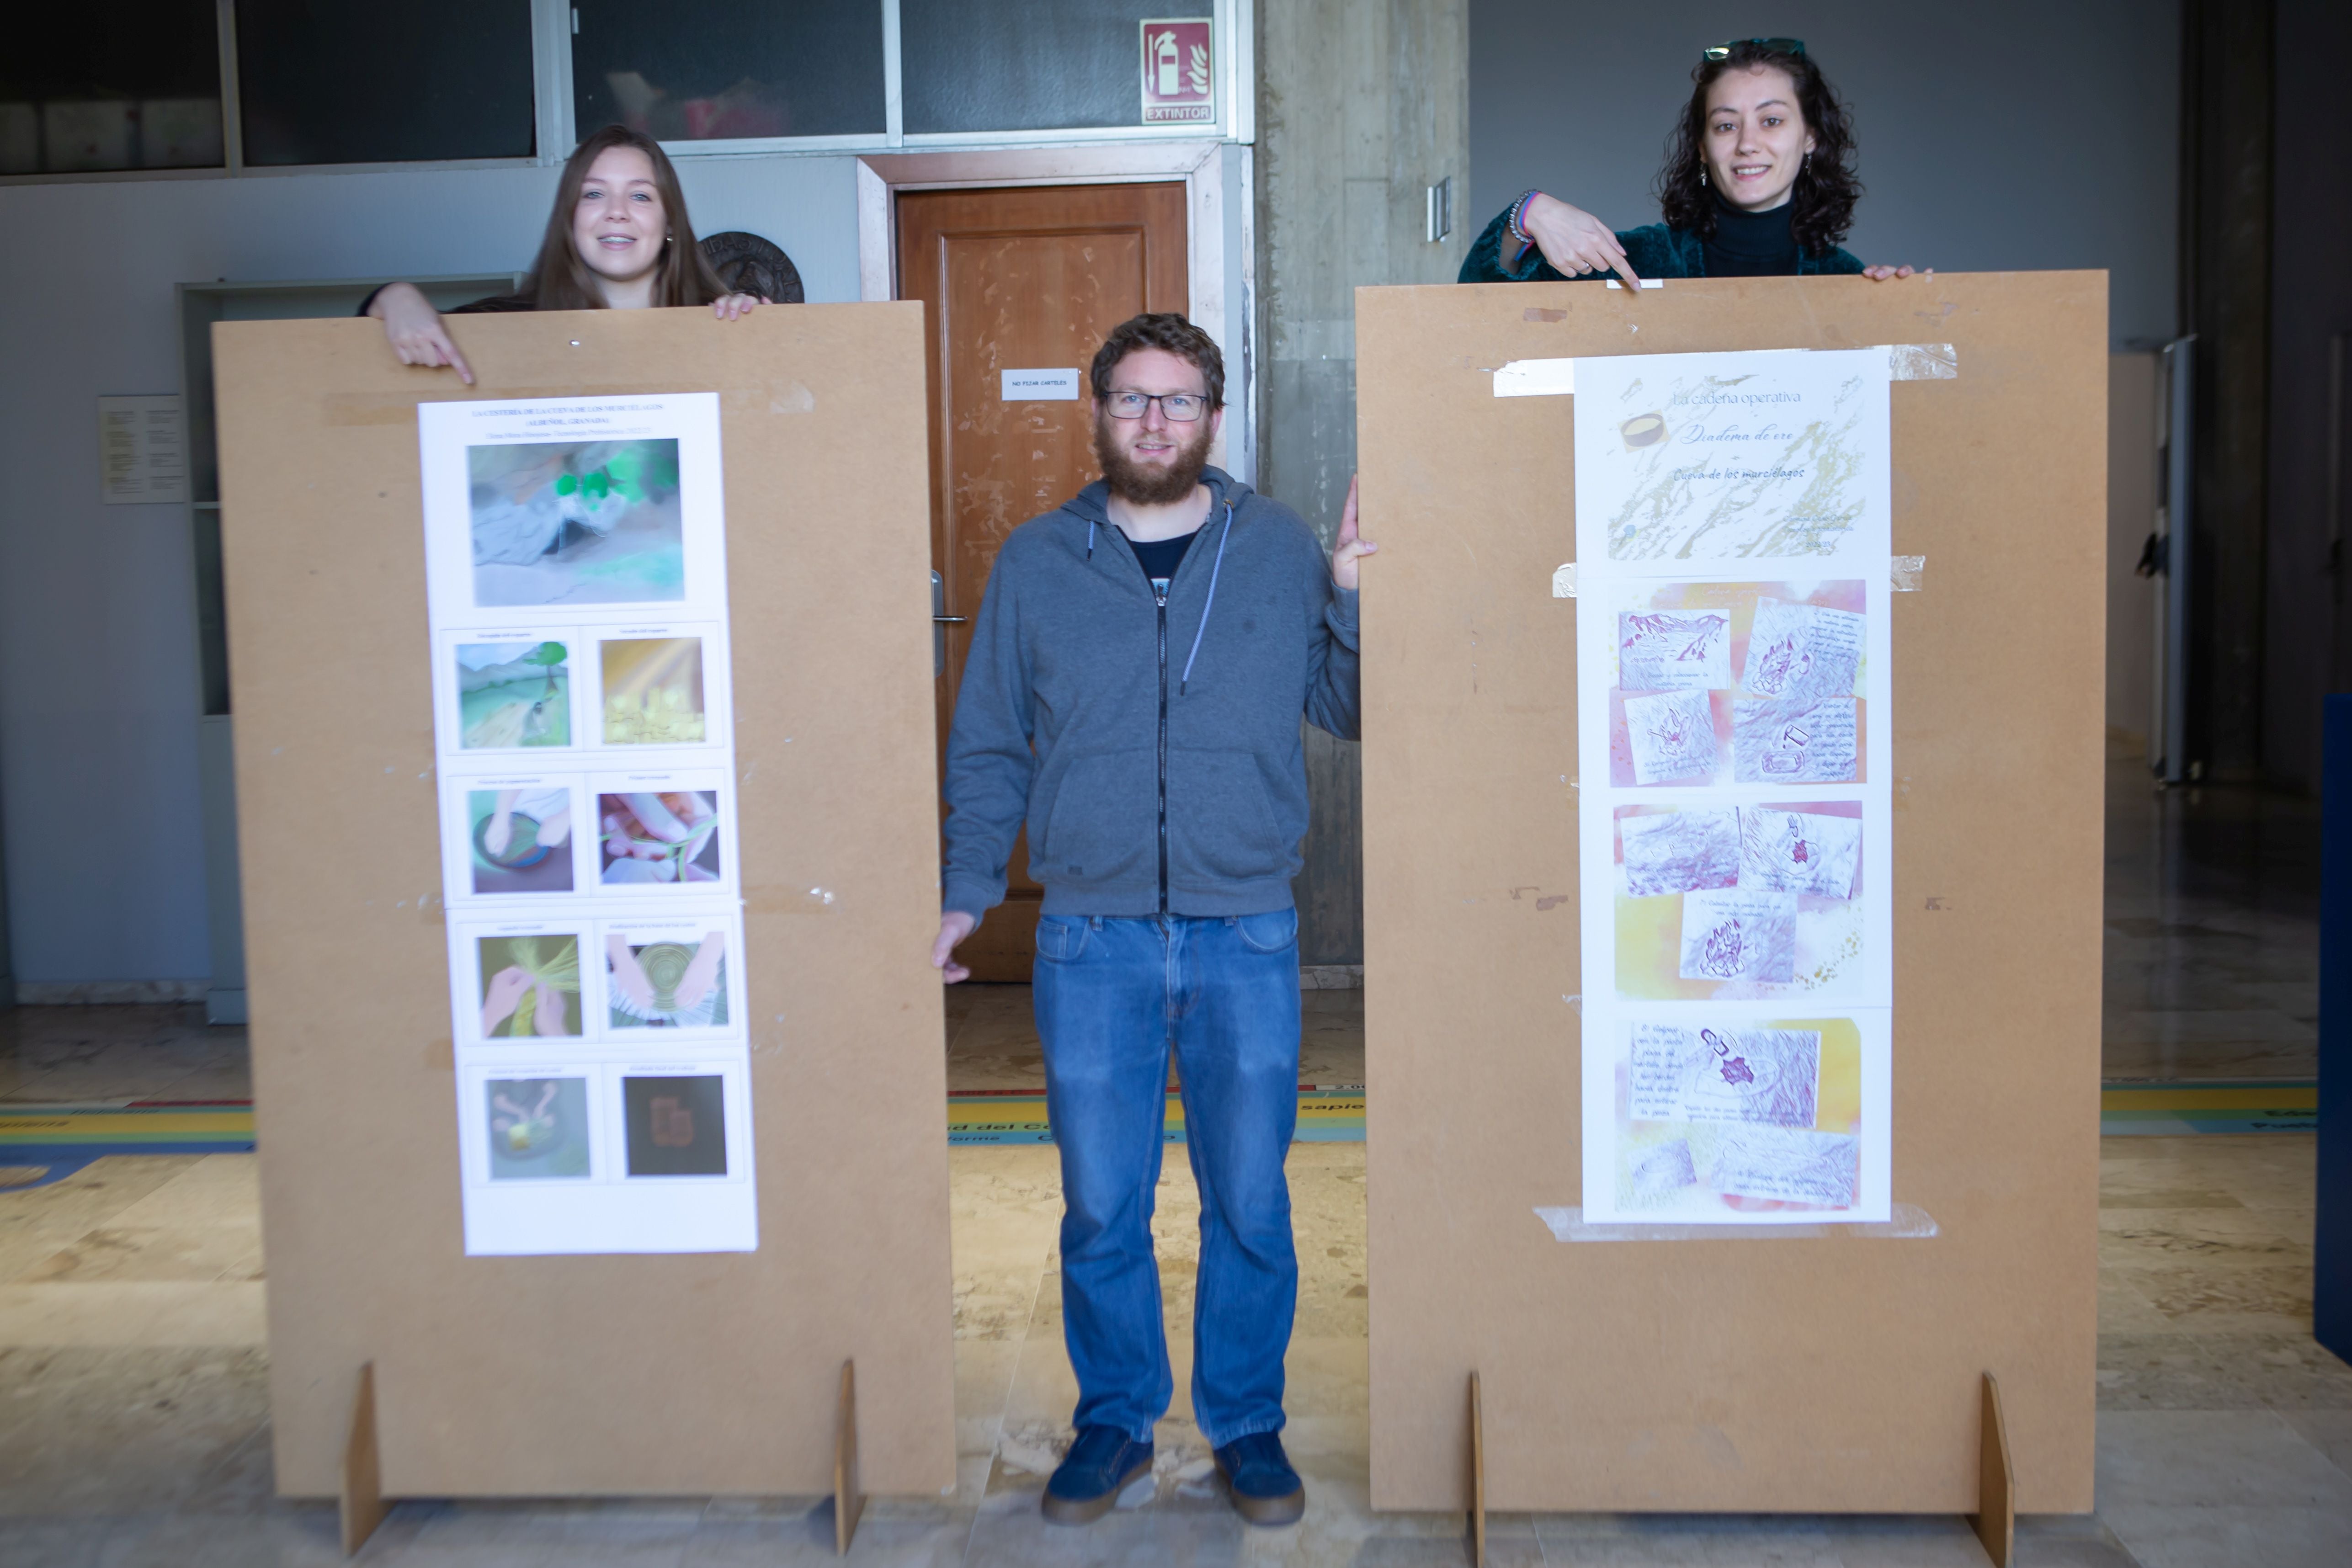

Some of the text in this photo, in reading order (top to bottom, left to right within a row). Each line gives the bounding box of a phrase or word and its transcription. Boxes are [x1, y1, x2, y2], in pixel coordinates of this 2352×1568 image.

[1147, 107, 1209, 120] EXTINTOR
[1673, 391, 1801, 407] La cadena operativa
[547, 406, 575, 415] CUEVA
[1679, 423, 1750, 444] Diadema
[1754, 423, 1778, 441] de
[1673, 466, 1805, 481] Cueva de los murciélagos
